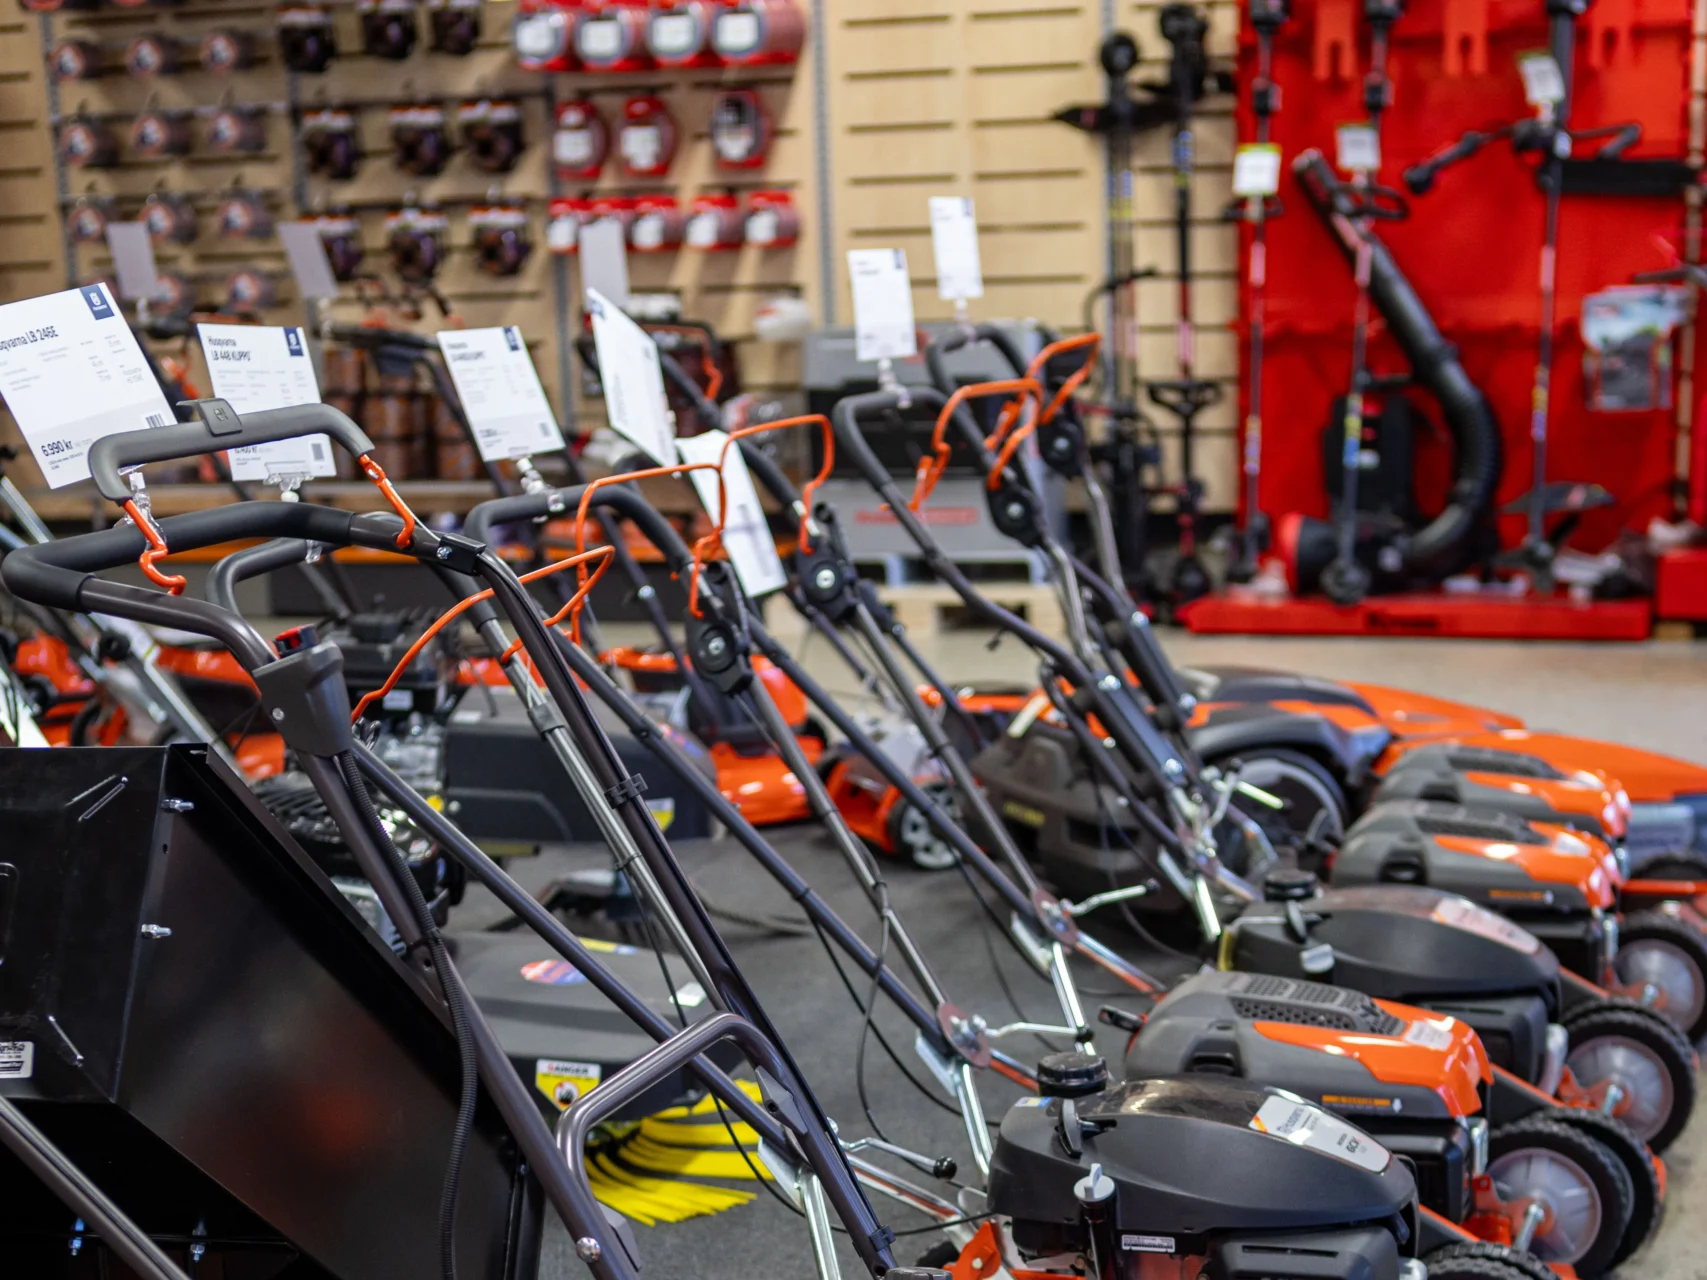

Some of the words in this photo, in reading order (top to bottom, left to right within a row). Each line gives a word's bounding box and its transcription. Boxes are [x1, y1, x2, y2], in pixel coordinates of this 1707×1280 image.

[25, 331, 38, 343] LB
[36, 325, 59, 341] 246E
[41, 440, 65, 457] 6.990
[62, 439, 74, 450] kr
